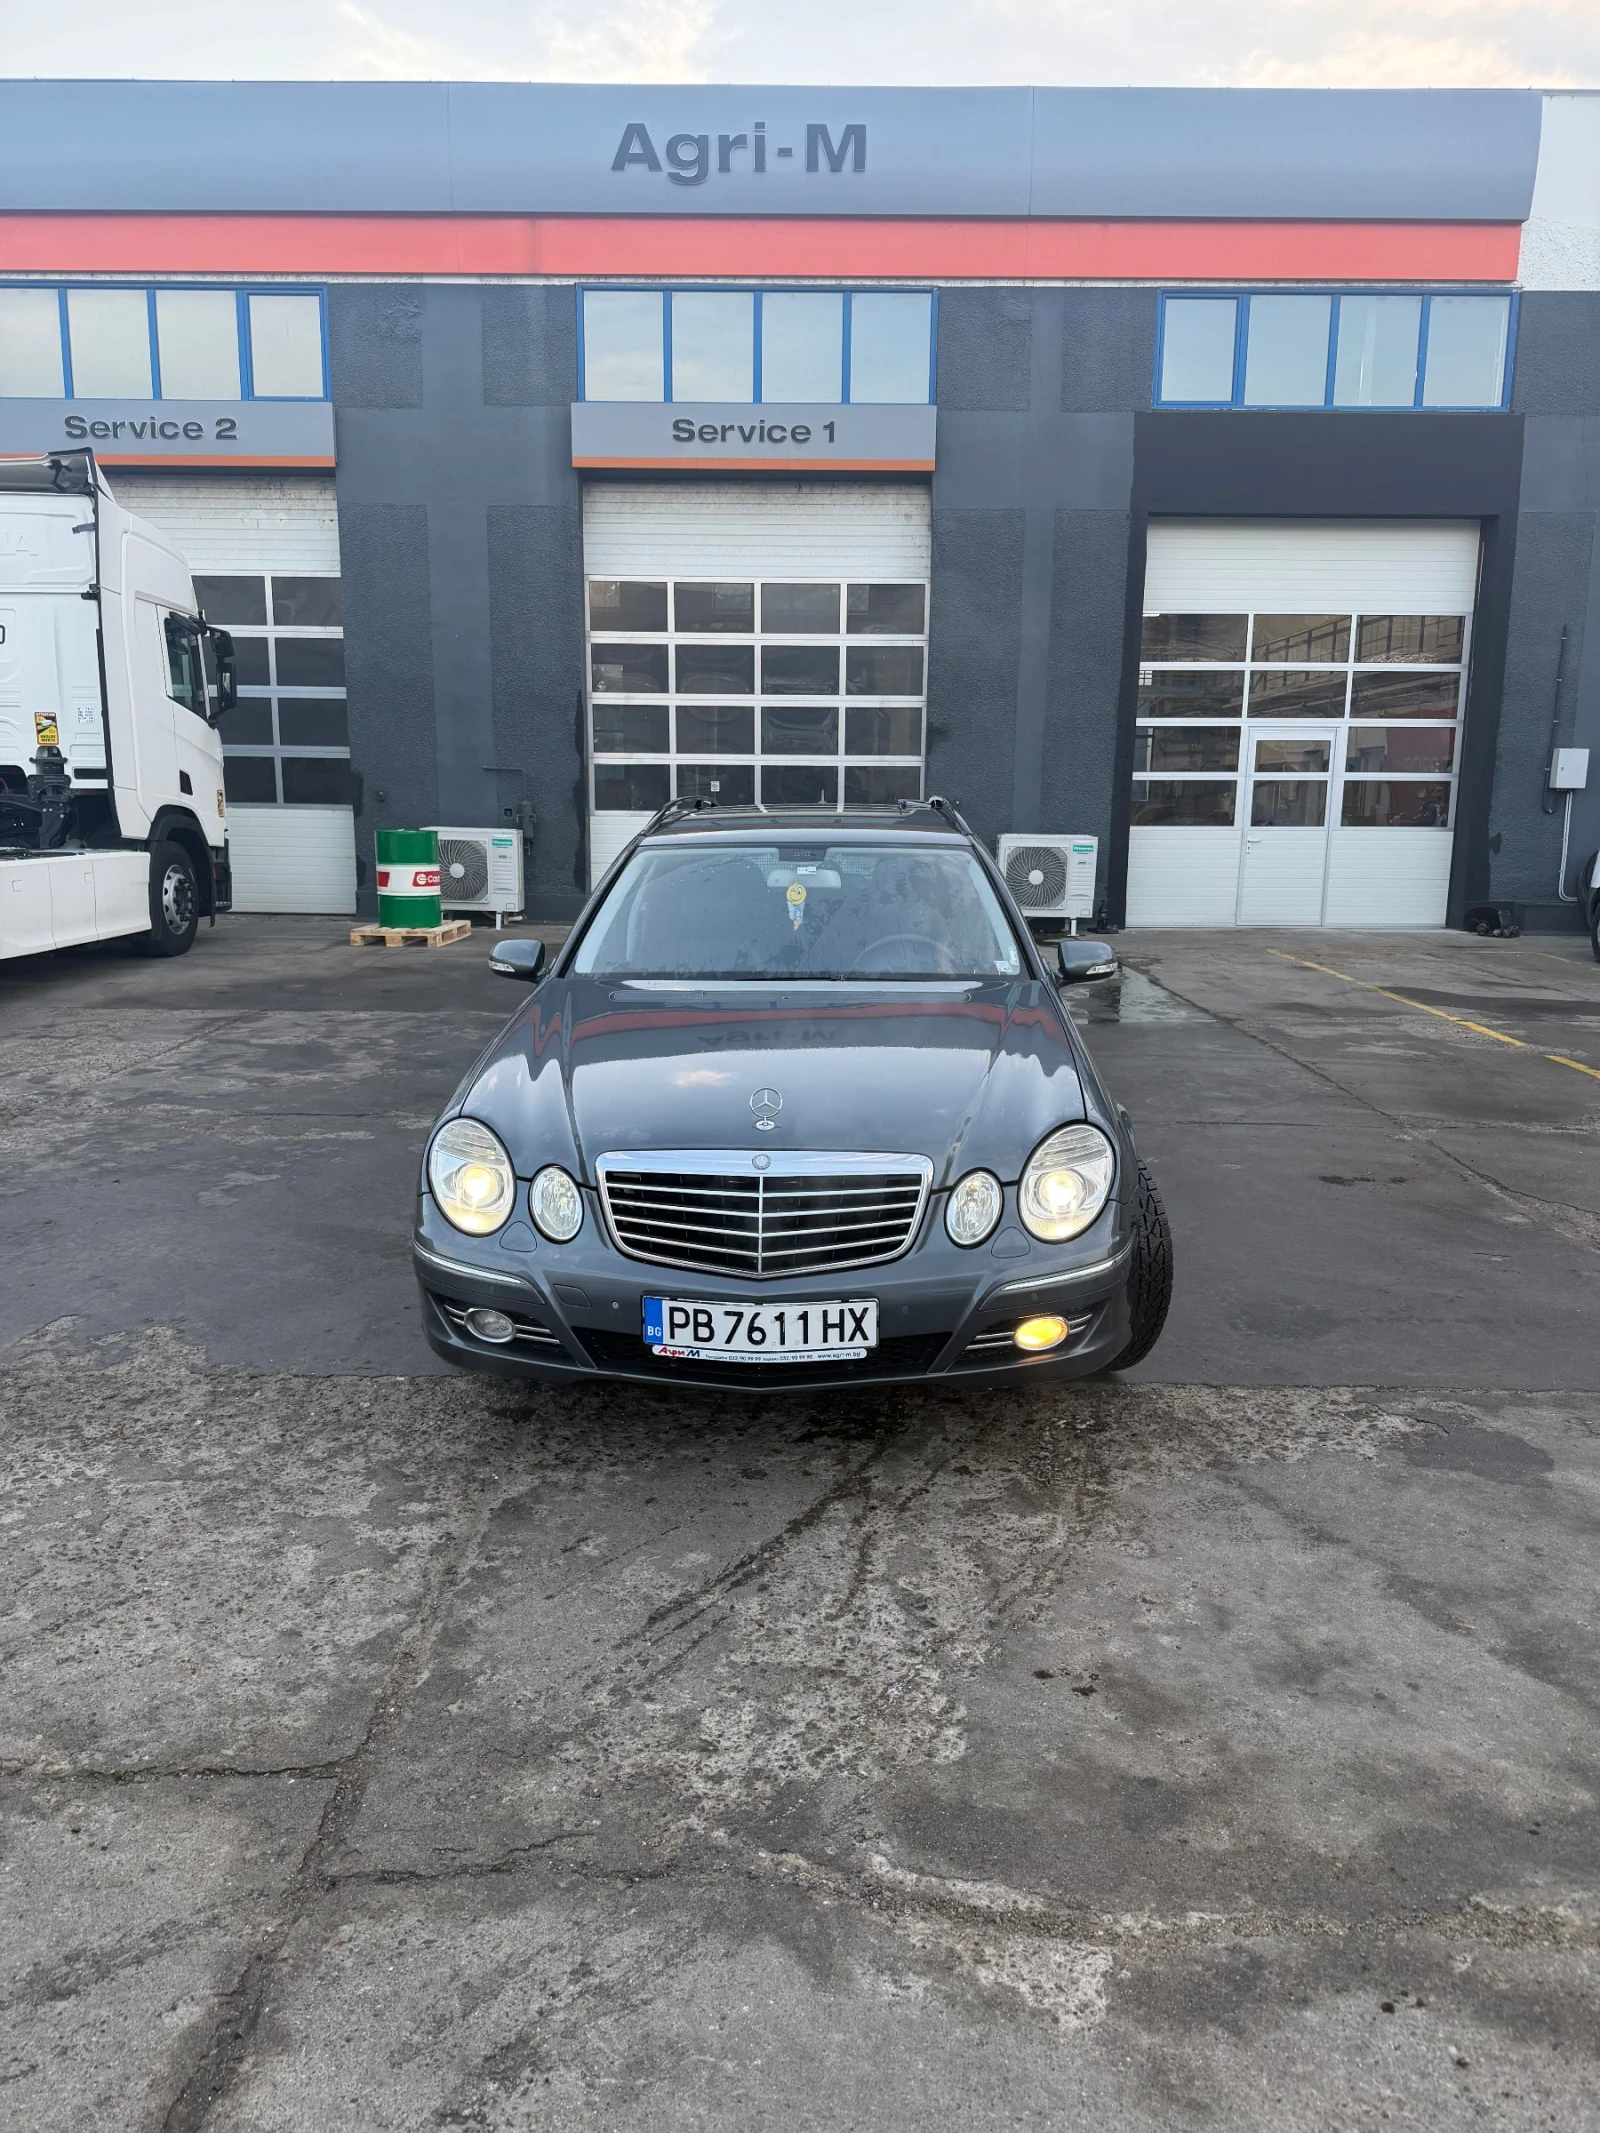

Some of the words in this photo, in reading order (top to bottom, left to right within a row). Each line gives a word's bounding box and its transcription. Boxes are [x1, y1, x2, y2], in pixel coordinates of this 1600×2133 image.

[611, 121, 868, 186] Agri-M
[64, 415, 206, 441] Service
[214, 417, 239, 441] 2
[672, 418, 812, 444] Service
[822, 420, 836, 444] 1
[647, 1325, 662, 1338] BG
